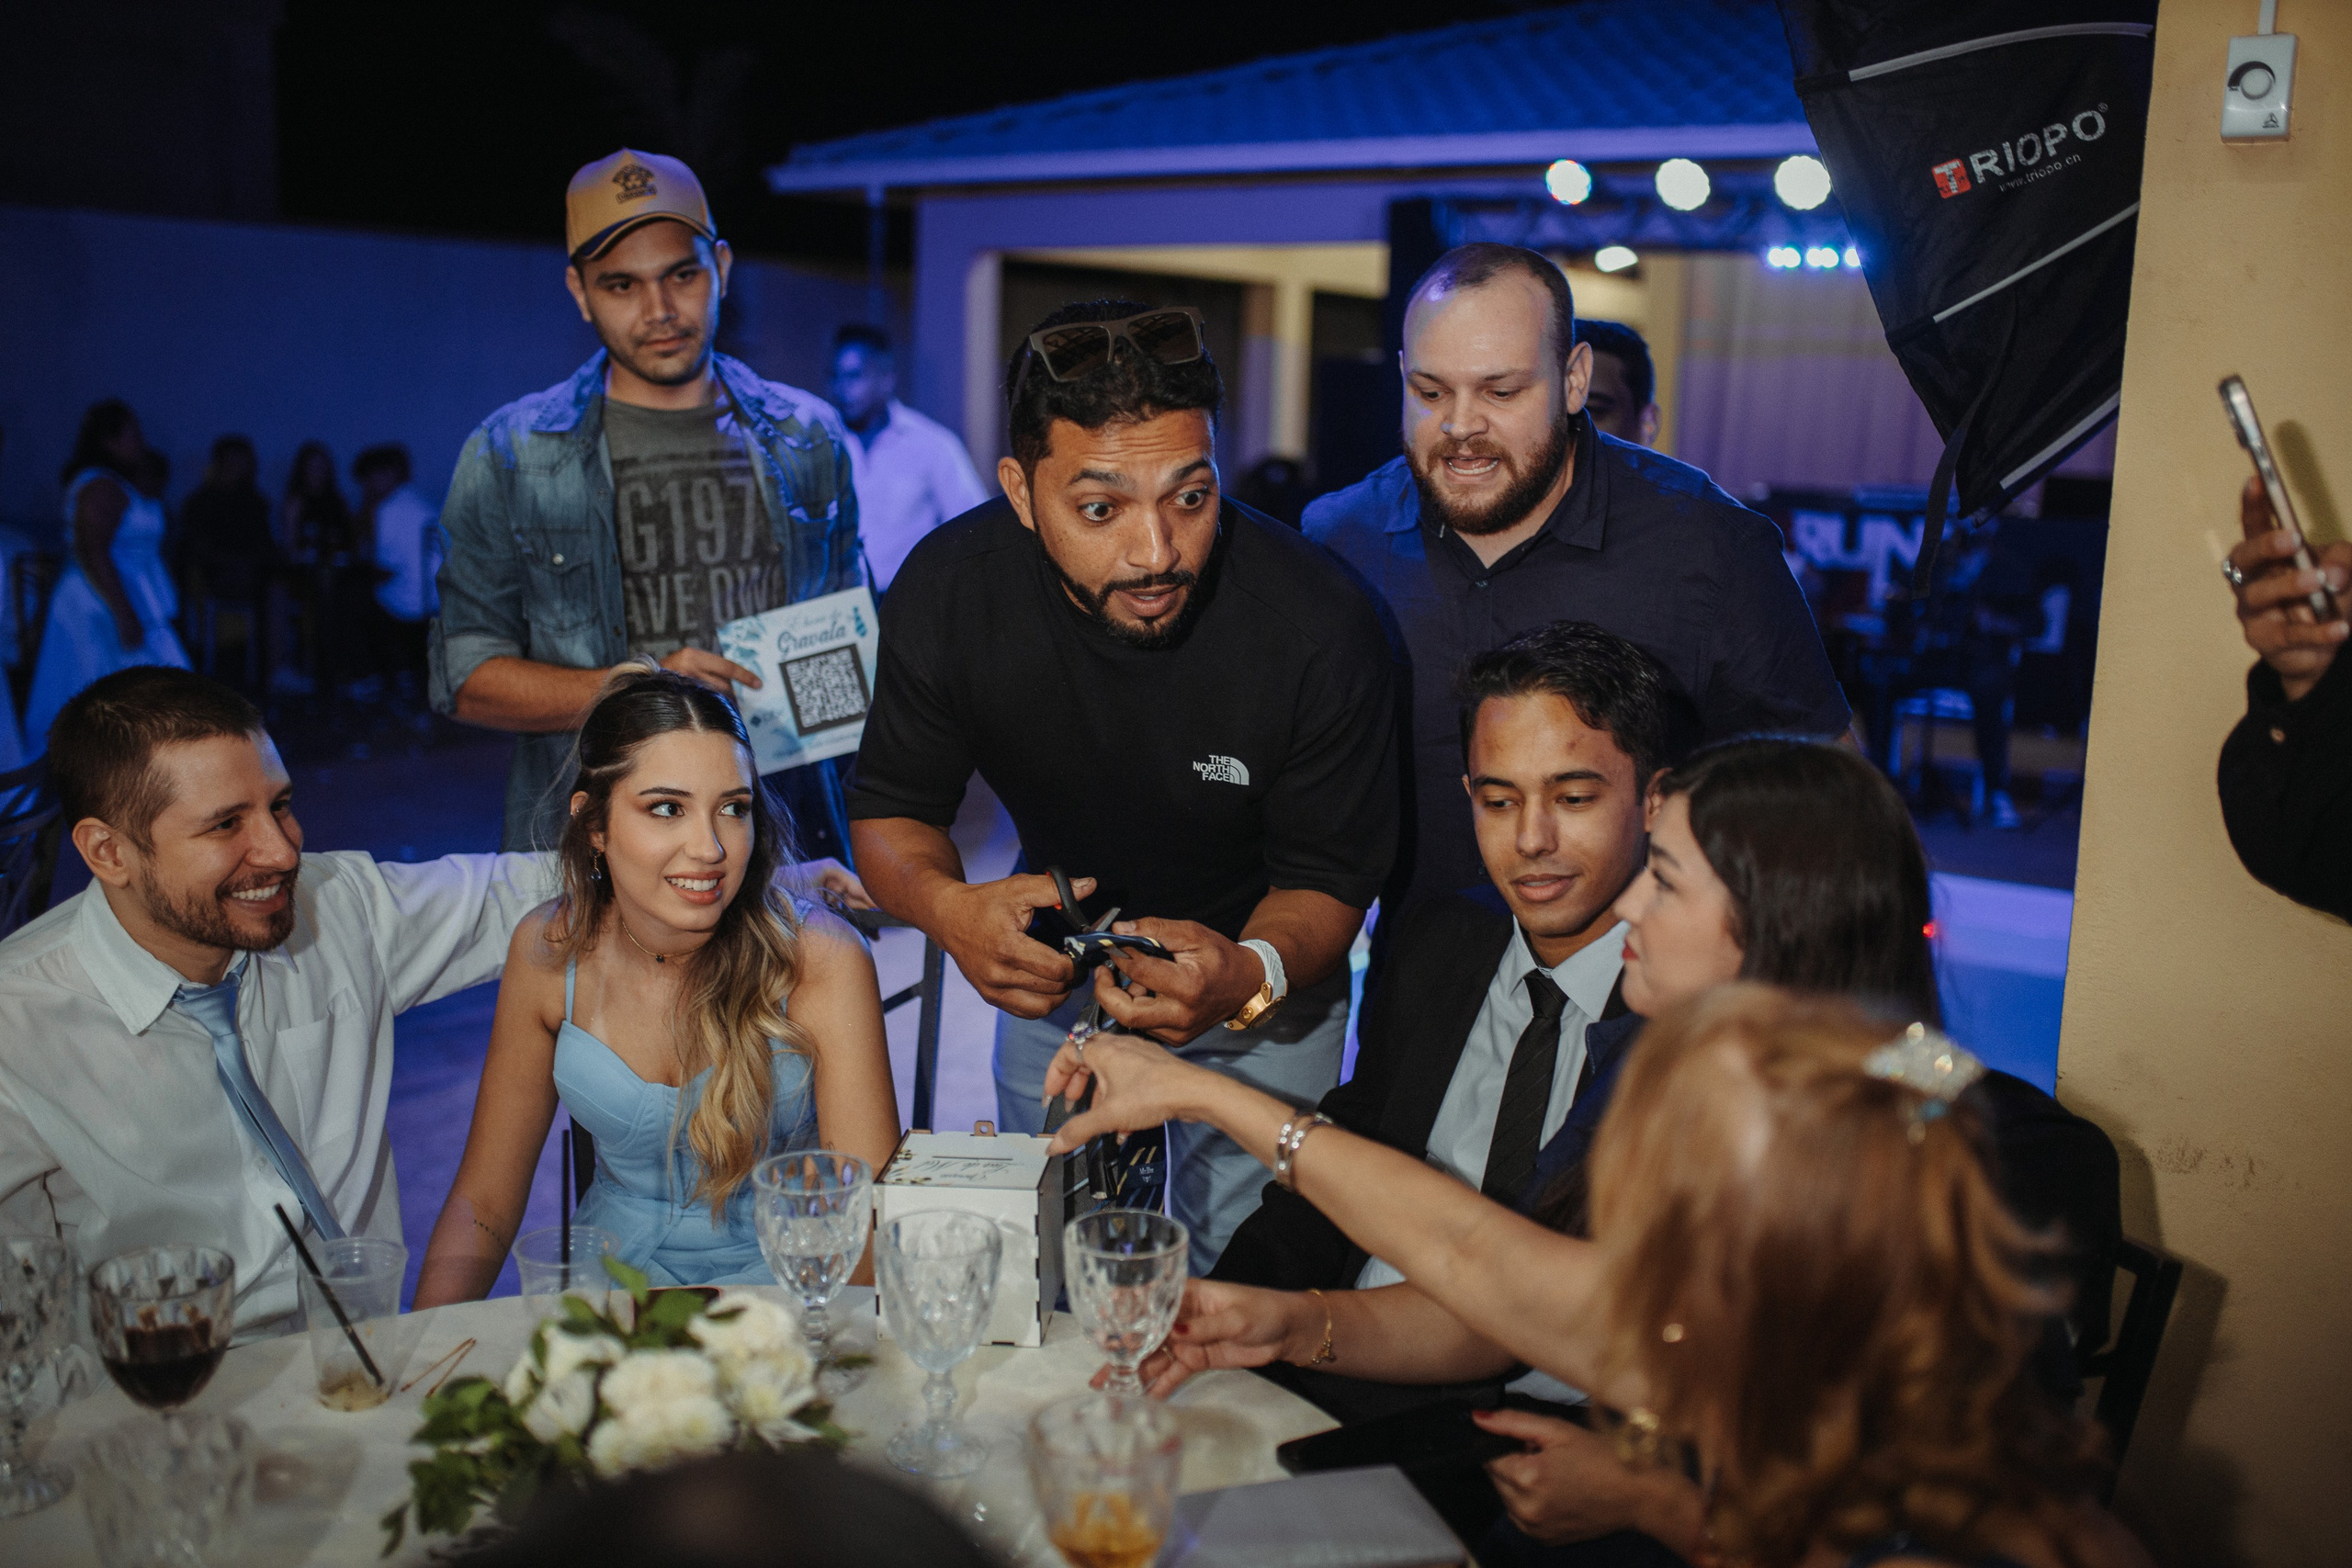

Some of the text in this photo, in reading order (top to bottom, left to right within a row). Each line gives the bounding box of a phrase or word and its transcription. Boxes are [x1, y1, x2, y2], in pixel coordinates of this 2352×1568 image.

[1933, 109, 2106, 194] TRIOPO
[1999, 153, 2082, 192] www.triopo.cn
[1208, 754, 1230, 765] THE
[1193, 761, 1230, 773] NORTH
[1202, 772, 1230, 783] FACE
